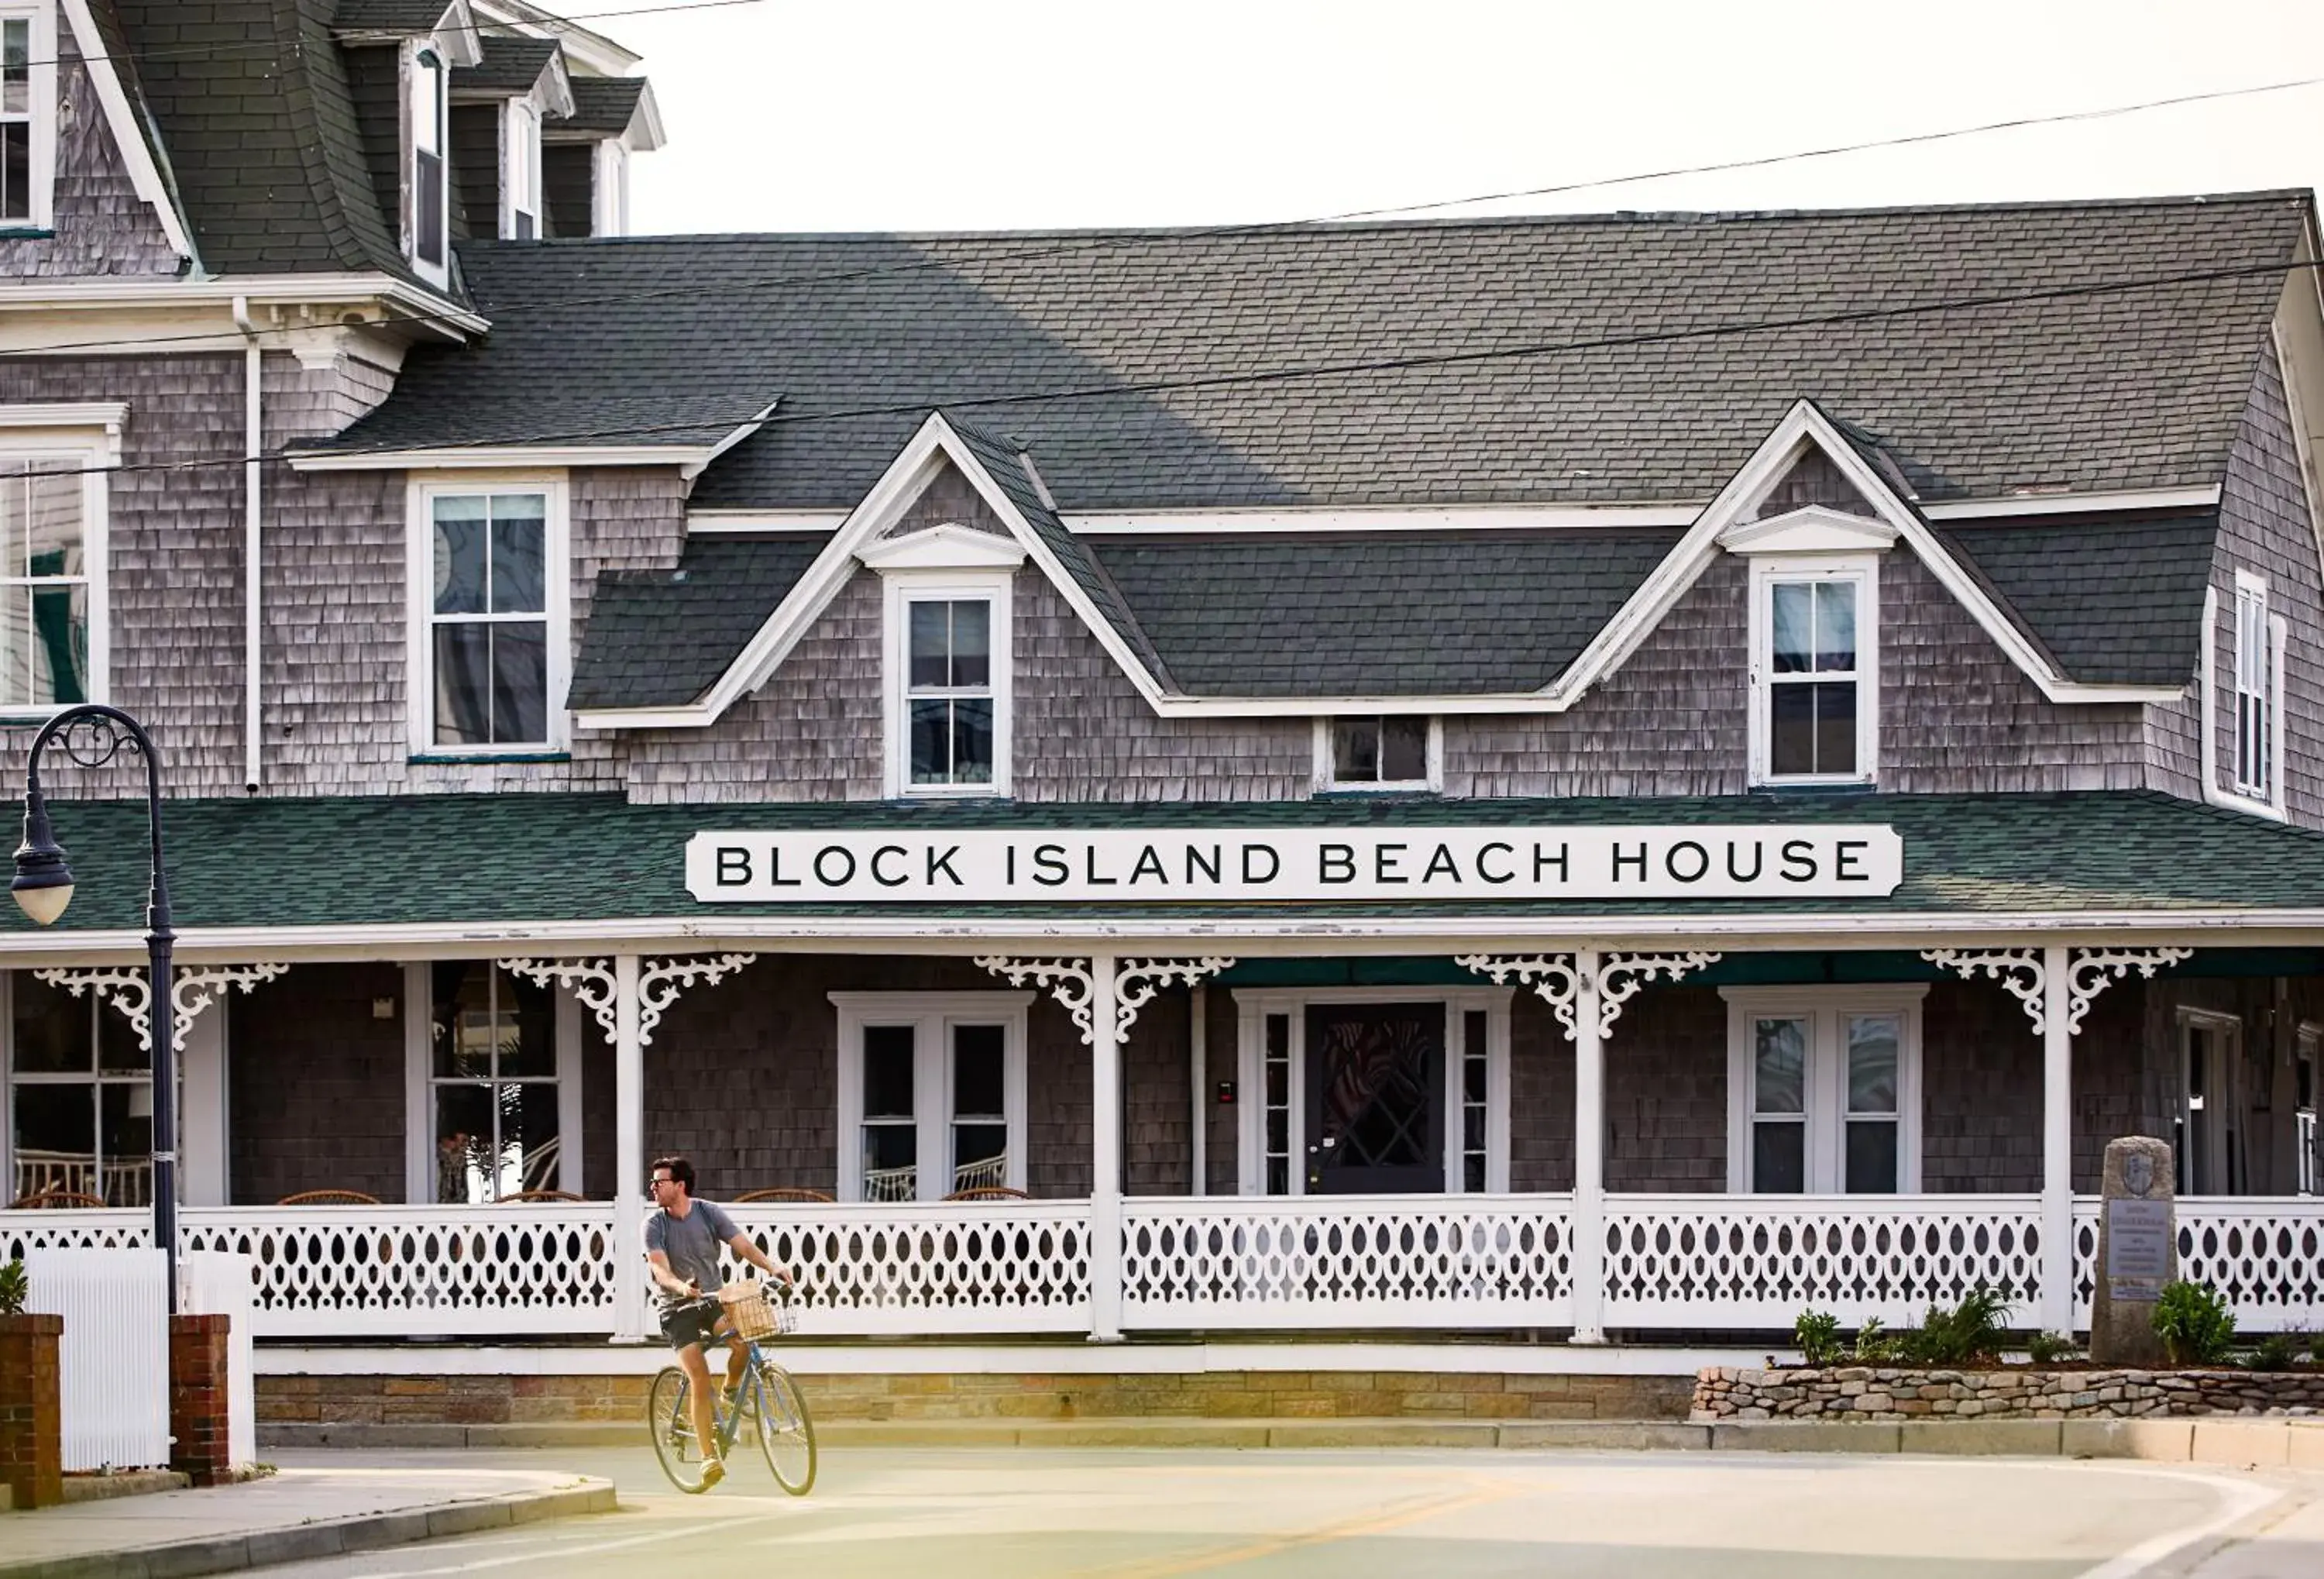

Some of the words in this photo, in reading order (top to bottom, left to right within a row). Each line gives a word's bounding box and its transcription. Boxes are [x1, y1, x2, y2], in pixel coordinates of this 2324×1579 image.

[717, 845, 964, 887] BLOCK
[1007, 844, 1280, 886] ISLAND
[1319, 842, 1568, 884] BEACH
[1612, 840, 1869, 883] HOUSE
